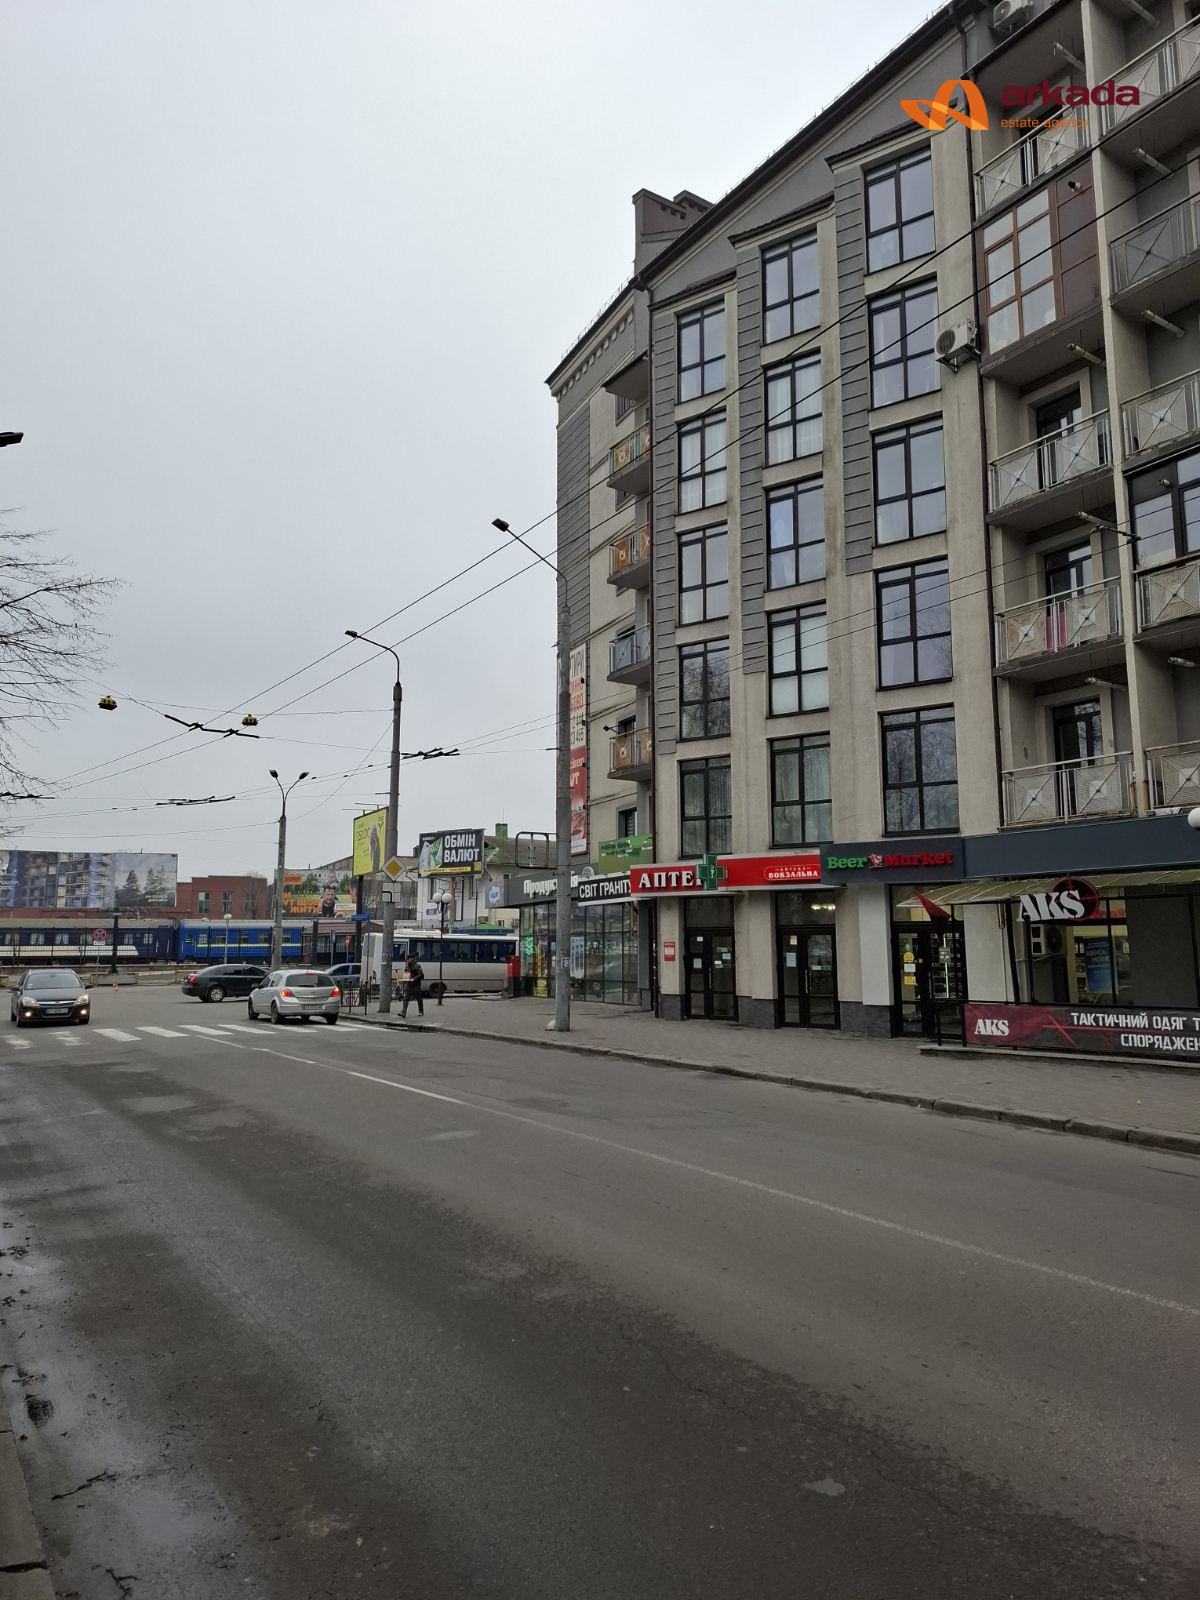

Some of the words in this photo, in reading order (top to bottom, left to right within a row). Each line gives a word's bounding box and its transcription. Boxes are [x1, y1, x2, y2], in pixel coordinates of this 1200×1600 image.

[444, 834, 476, 848] ОБМІН
[444, 848, 480, 863] ВАЛЮТ
[827, 856, 867, 869] Beer
[884, 850, 953, 867] Market
[638, 870, 702, 889] АПТЕ
[768, 870, 819, 879] ВОКЗАЛЬНА
[579, 883, 598, 899] СВІТ
[1016, 889, 1085, 922] AKS
[973, 1018, 1010, 1037] AKS
[1070, 1012, 1149, 1029] ТАКТИЧНИЙ
[1152, 1015, 1187, 1031] ОДЯГ
